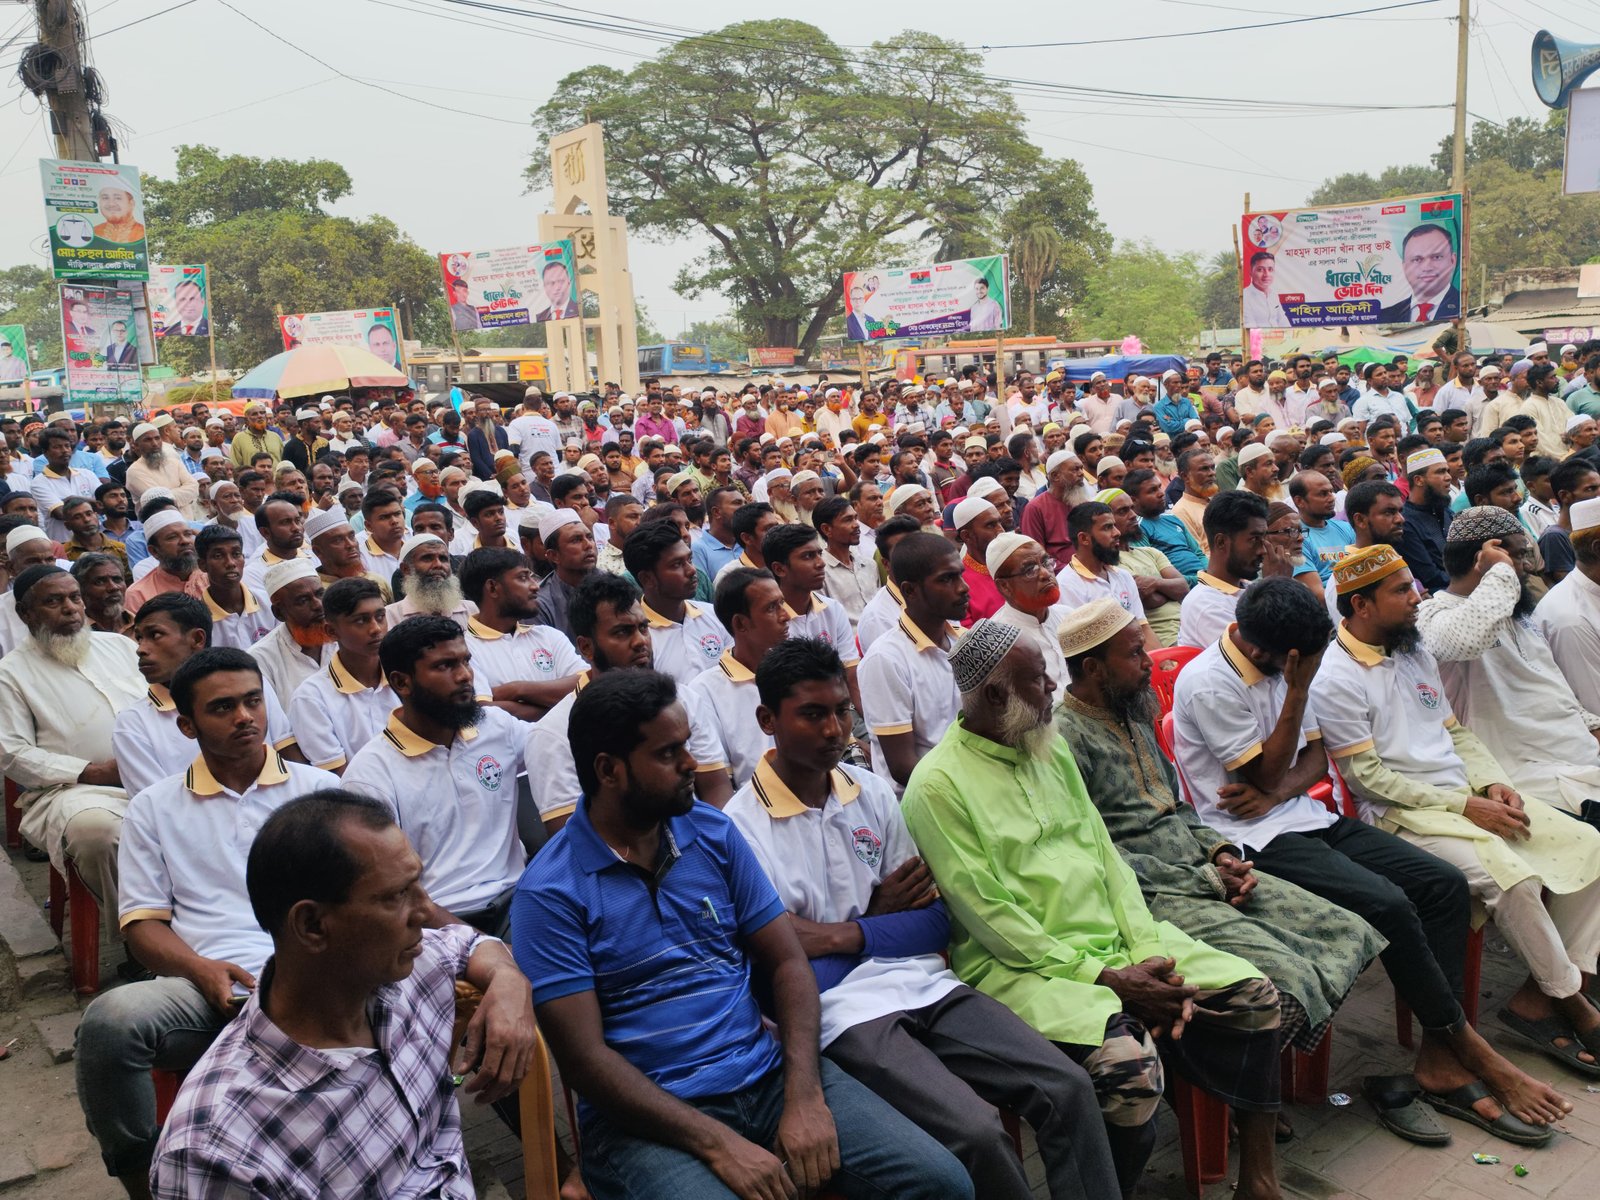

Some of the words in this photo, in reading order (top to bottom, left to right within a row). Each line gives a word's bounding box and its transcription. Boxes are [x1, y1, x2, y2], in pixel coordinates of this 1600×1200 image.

[57, 248, 76, 257] মোঃ
[77, 248, 104, 260] রুহুল
[105, 247, 135, 260] আমিন
[1285, 248, 1311, 258] মাহমুদ
[1313, 246, 1336, 256] হাসান
[1357, 243, 1373, 253] বাবু
[1376, 240, 1392, 251] ভাই
[1319, 258, 1335, 266] সালাম
[1325, 269, 1361, 287] ধানের
[1369, 269, 1392, 285] শীষে
[483, 290, 505, 302] ধানের
[1333, 283, 1363, 300] ভোট
[1364, 282, 1383, 297] দিন
[490, 298, 508, 311] ভোট
[507, 298, 519, 307] দিন
[1289, 303, 1322, 316] শহিদ
[1325, 301, 1373, 315] আফ্রিদী
